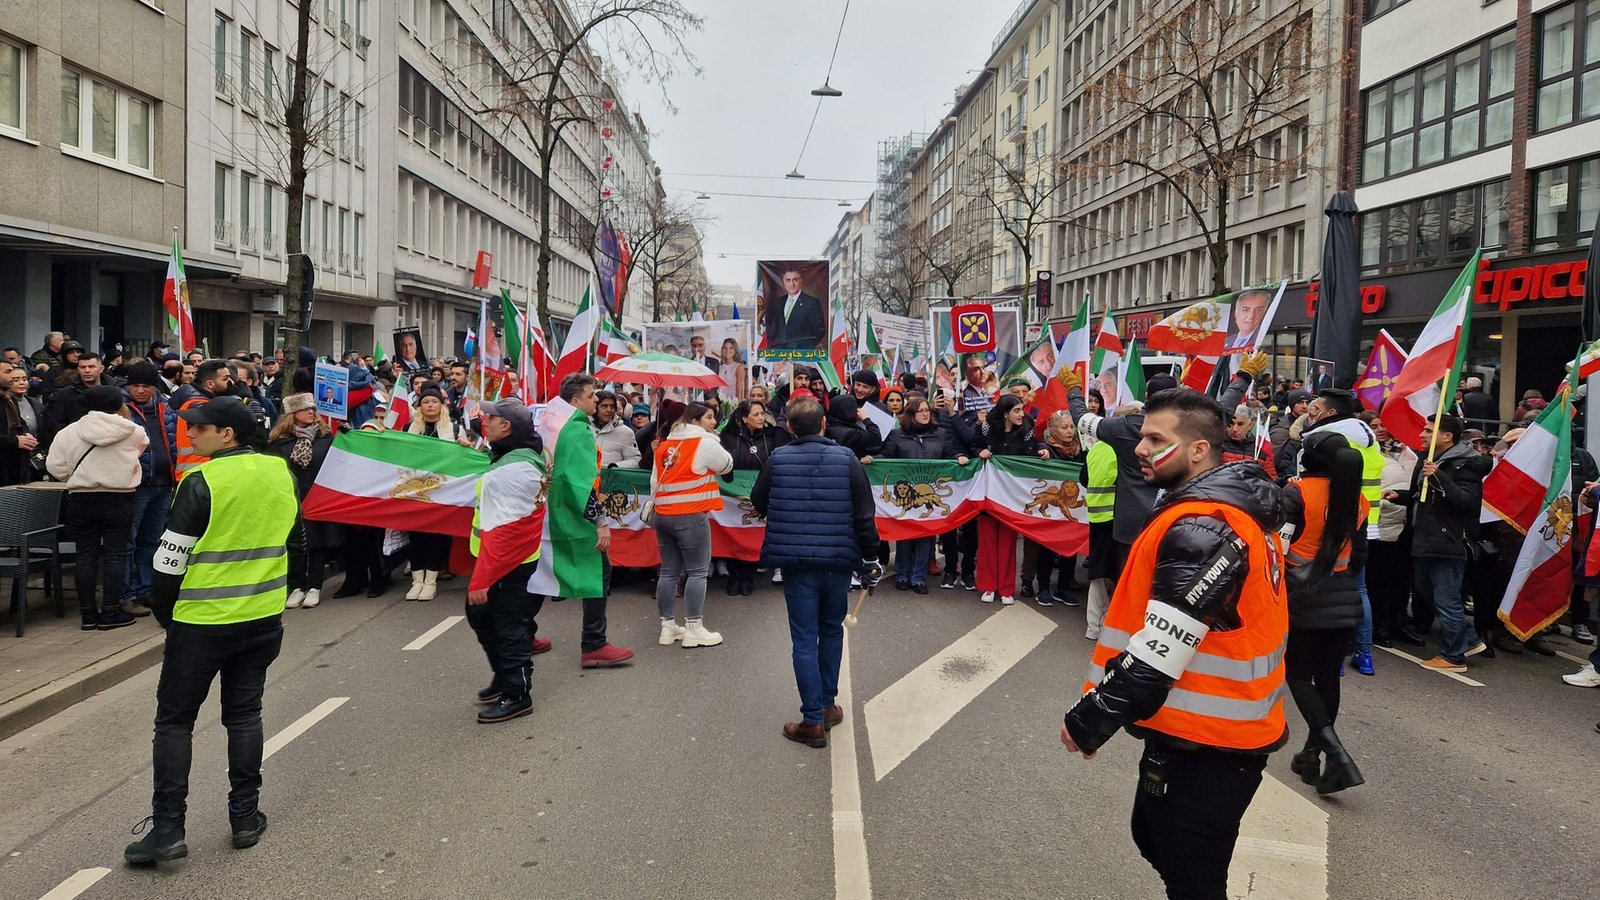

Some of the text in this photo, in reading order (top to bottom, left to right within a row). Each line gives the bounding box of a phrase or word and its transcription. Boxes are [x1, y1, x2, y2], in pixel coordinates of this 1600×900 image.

[160, 539, 193, 555] RDNE
[162, 556, 179, 568] 36
[1184, 555, 1231, 606] HYPE YOUTH
[1145, 611, 1202, 650] RDNER
[1145, 639, 1170, 658] 42
